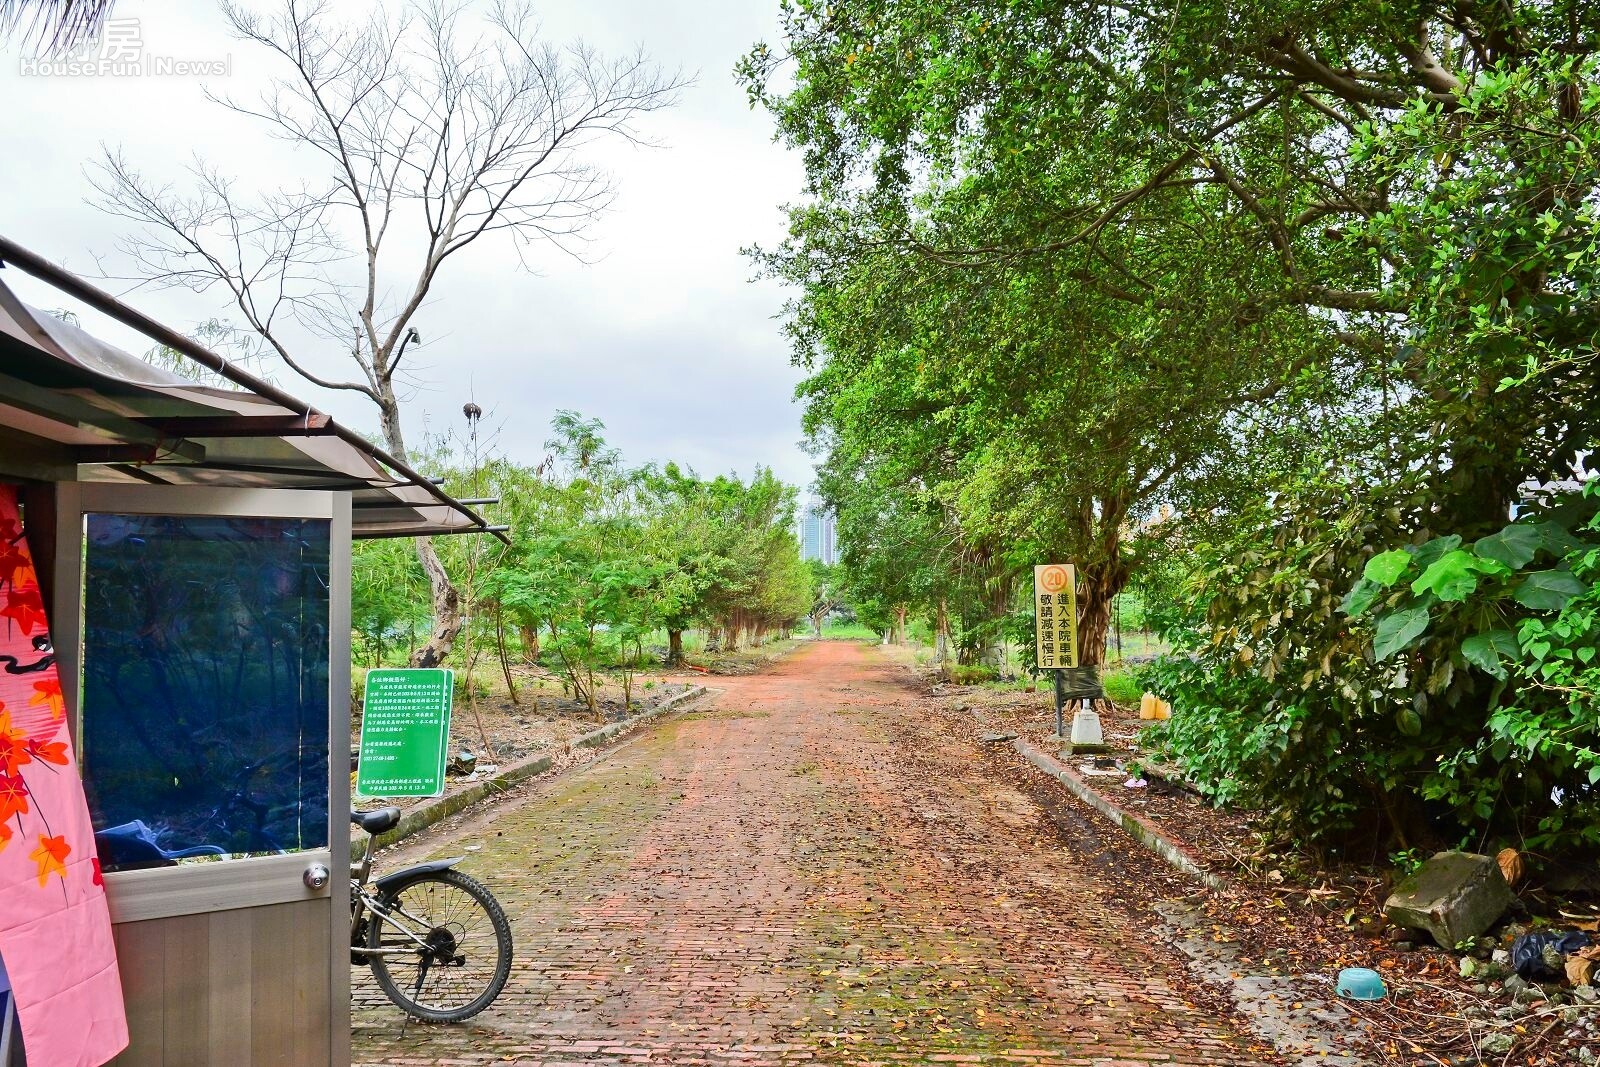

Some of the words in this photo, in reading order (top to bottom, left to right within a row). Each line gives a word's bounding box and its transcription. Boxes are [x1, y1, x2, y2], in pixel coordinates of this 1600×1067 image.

[1047, 572, 1062, 586] 20
[1040, 594, 1055, 667] 敬請減速慢行
[1057, 593, 1072, 667] 進入本院車輛
